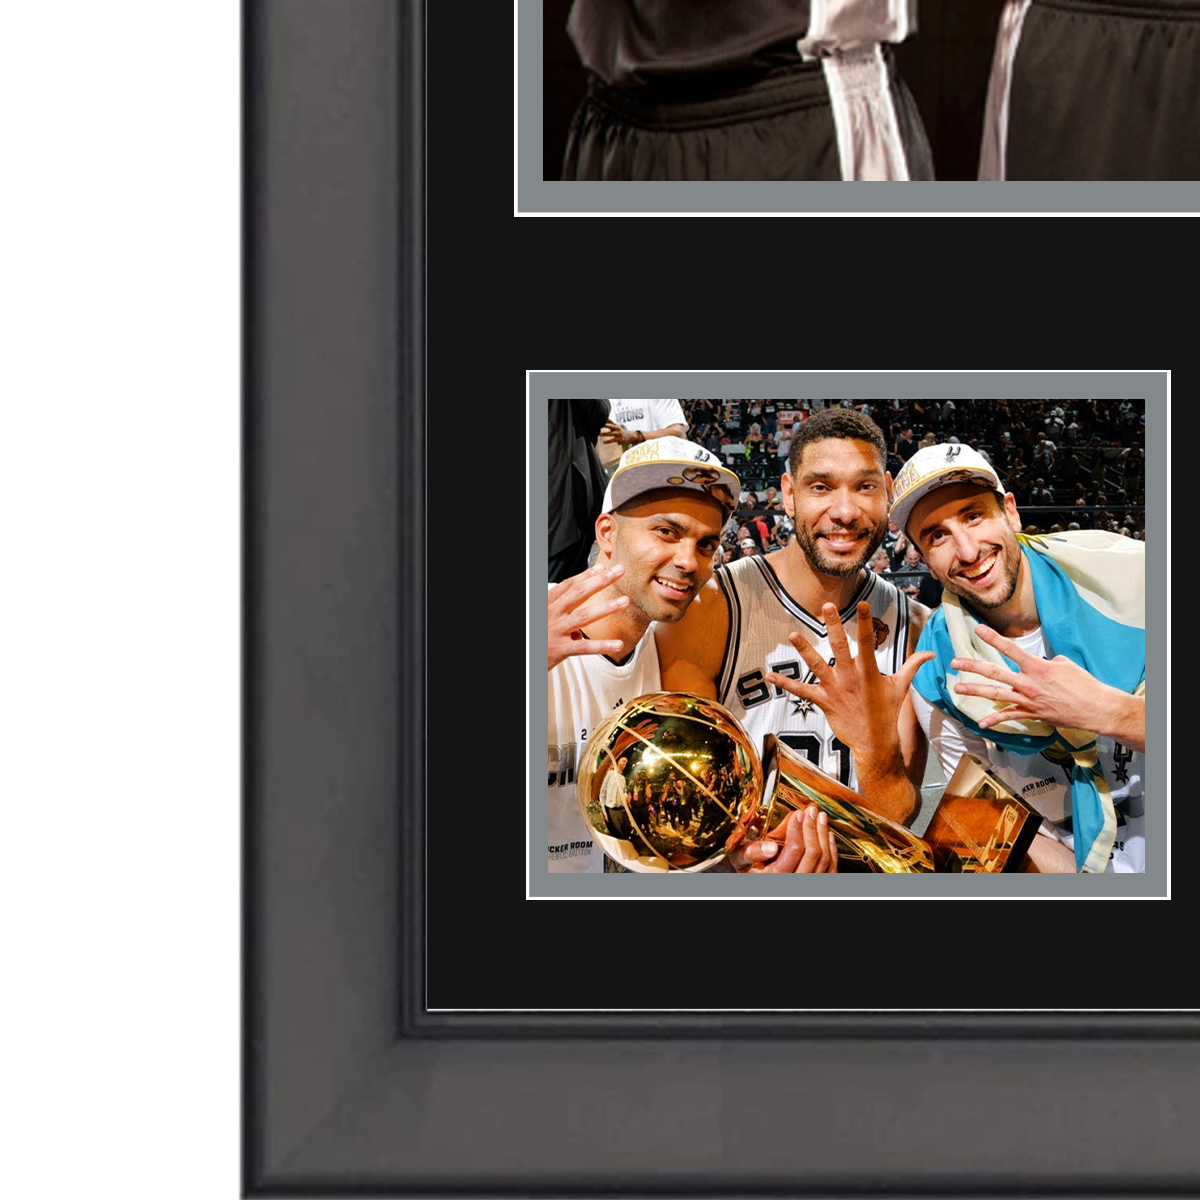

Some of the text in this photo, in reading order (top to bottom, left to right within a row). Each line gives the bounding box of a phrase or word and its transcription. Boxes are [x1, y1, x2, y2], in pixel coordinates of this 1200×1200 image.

[1035, 775, 1057, 789] ROOM
[547, 840, 593, 854] CKER ROOM
